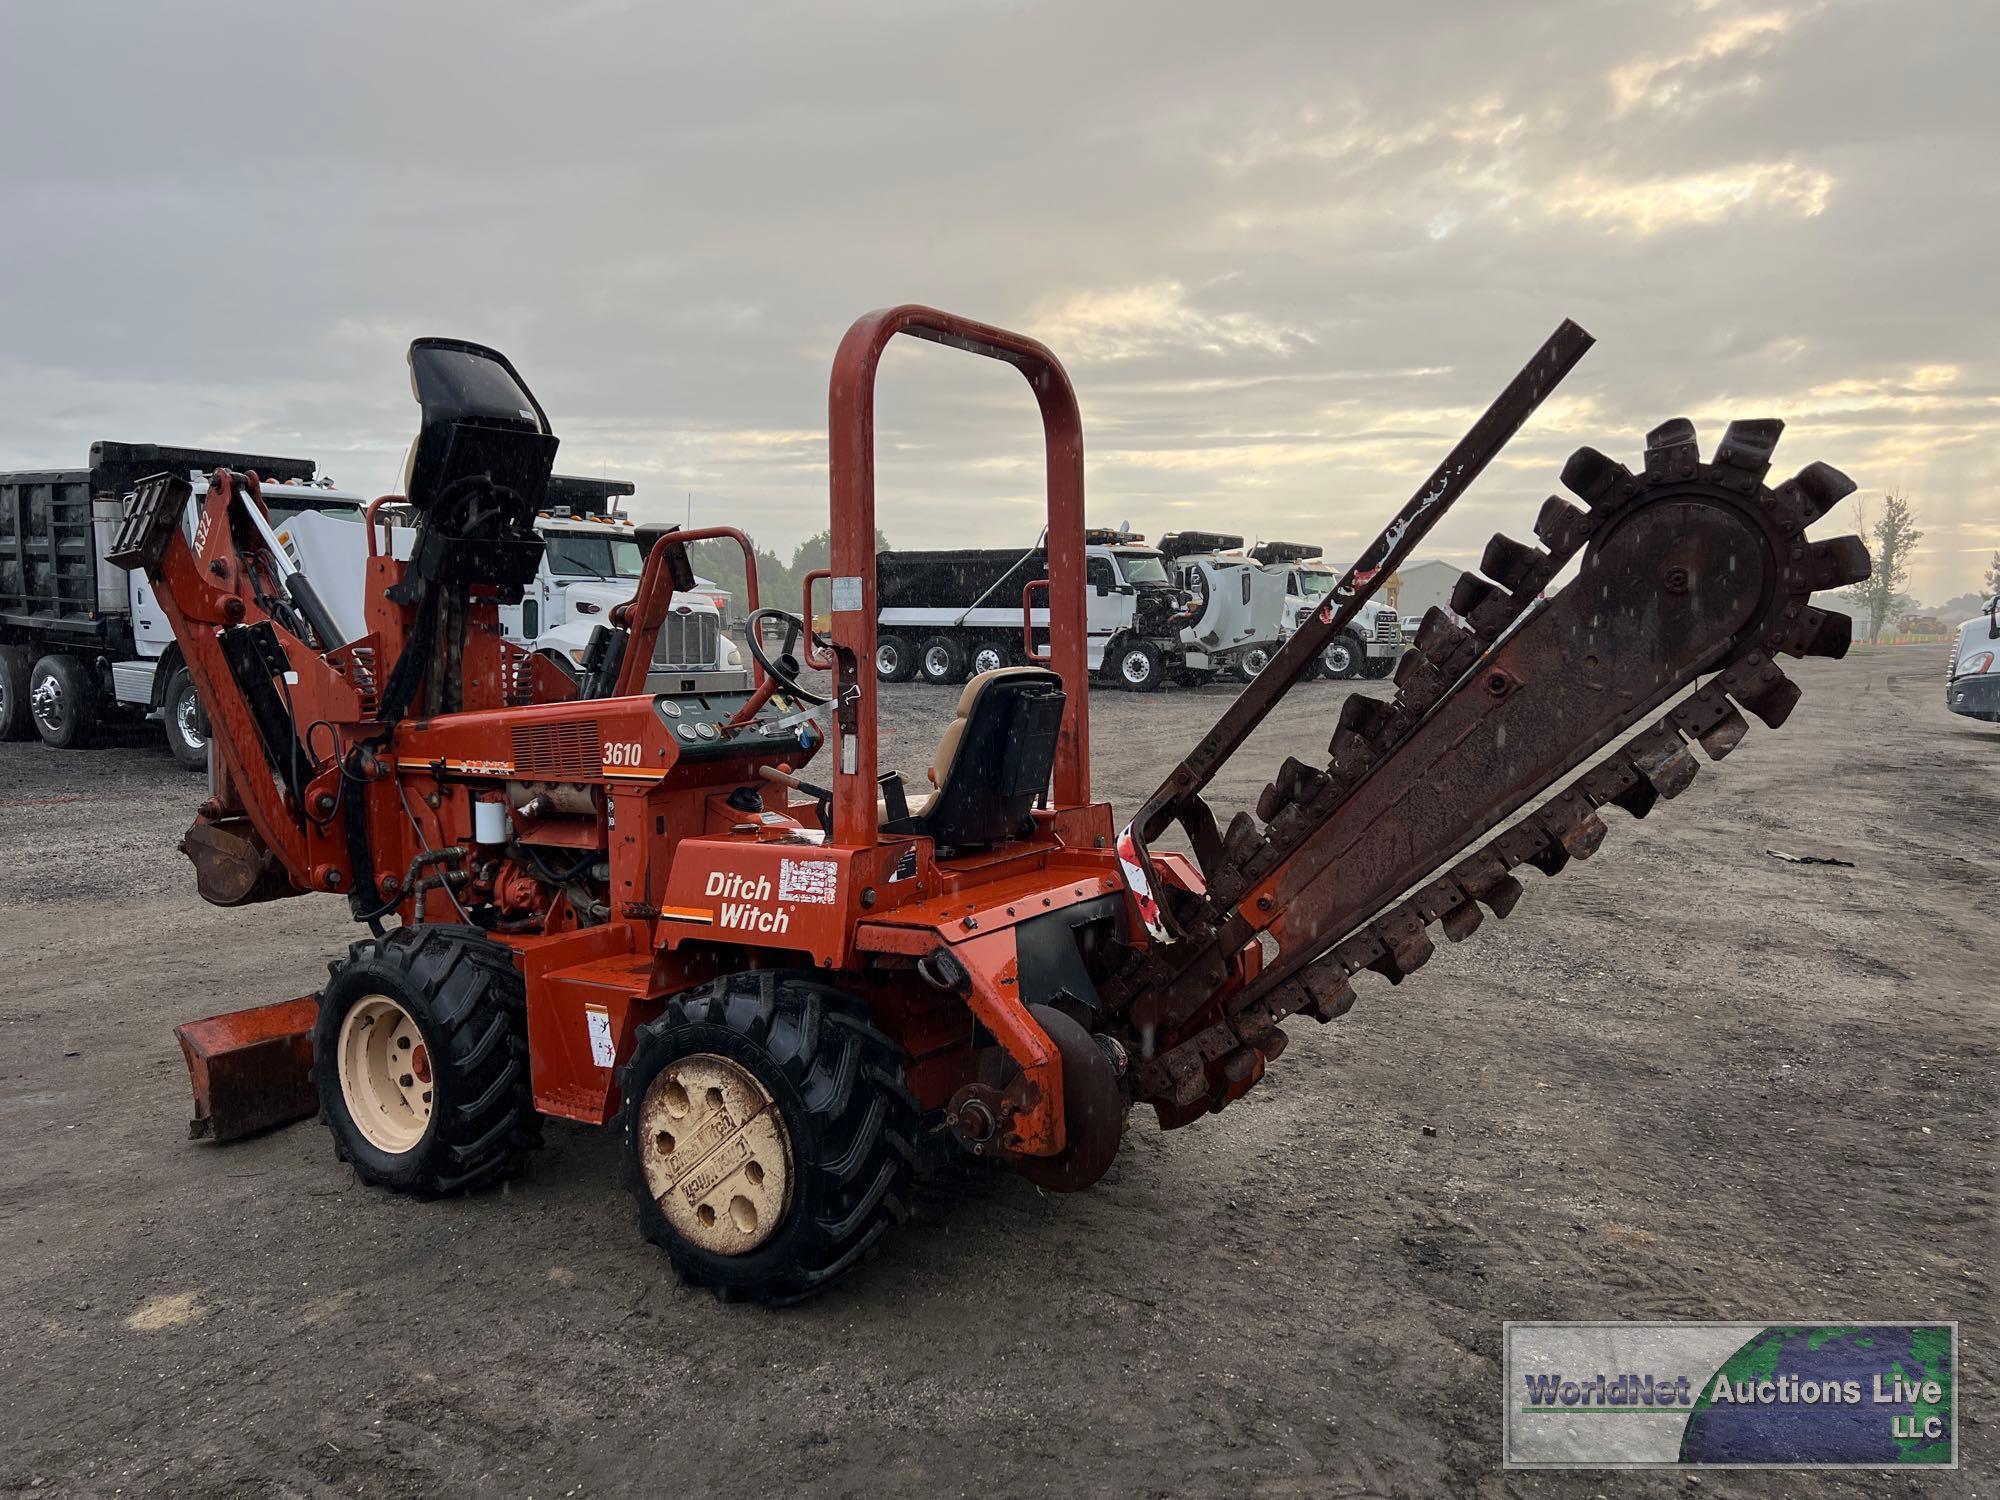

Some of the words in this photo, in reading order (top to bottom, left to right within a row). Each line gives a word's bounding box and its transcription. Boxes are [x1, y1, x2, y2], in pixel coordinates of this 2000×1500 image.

[194, 510, 212, 559] A322
[602, 742, 642, 766] 3610
[705, 871, 771, 900] Ditch
